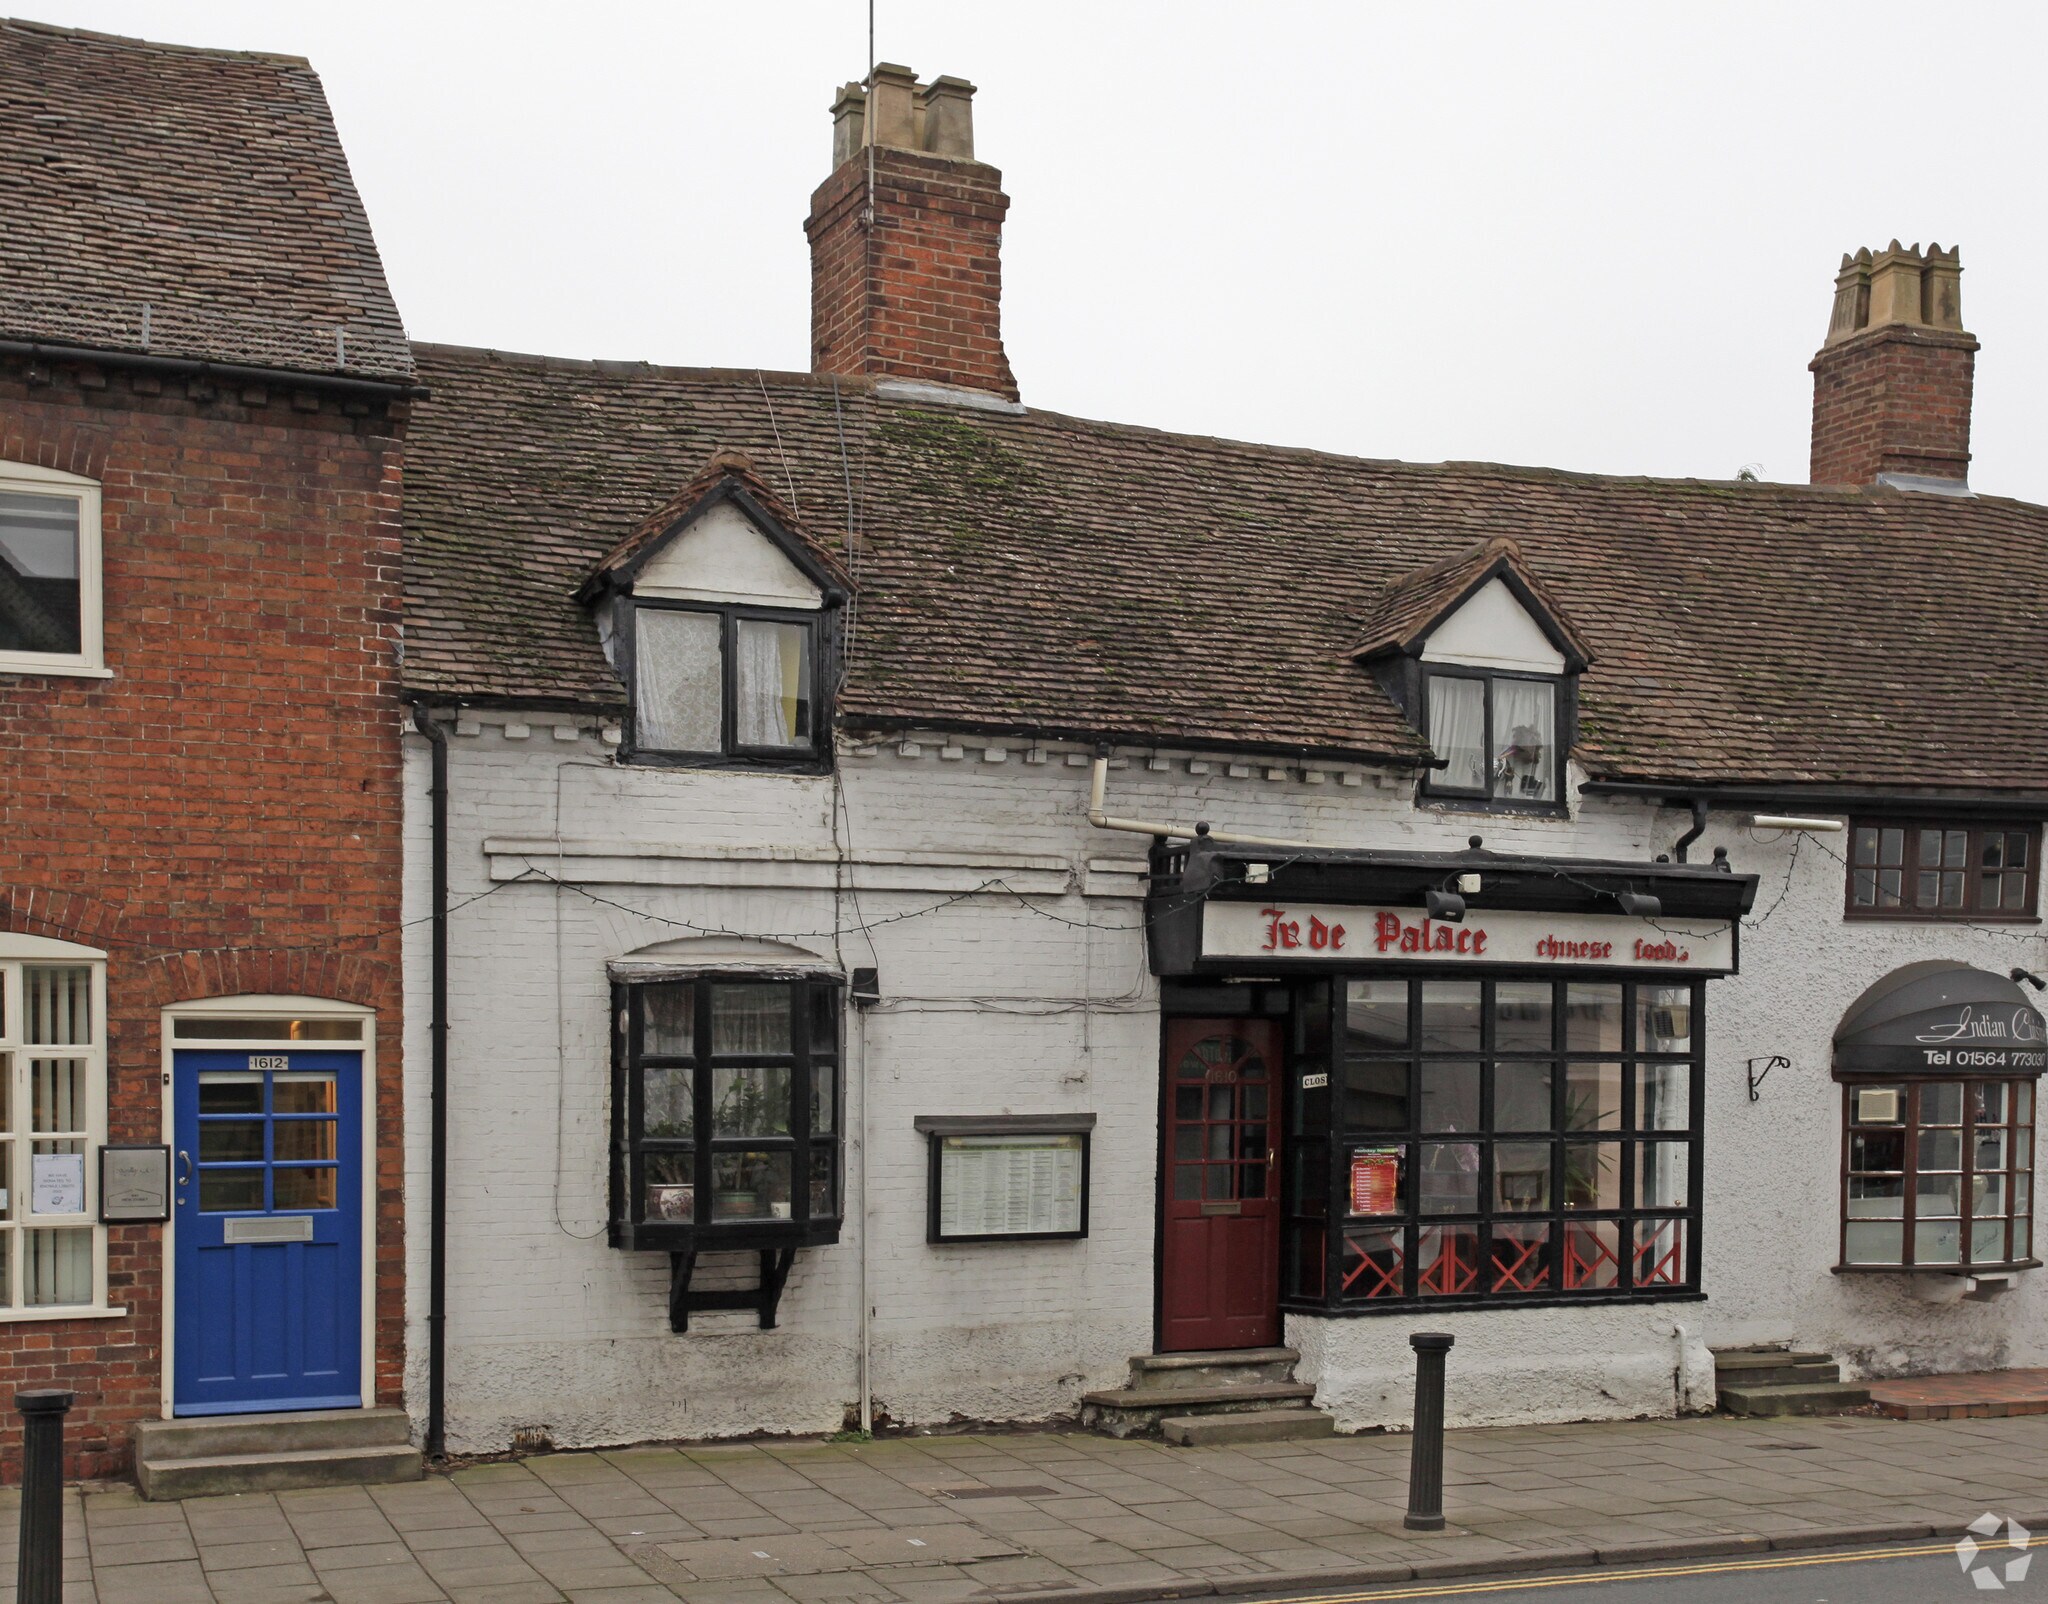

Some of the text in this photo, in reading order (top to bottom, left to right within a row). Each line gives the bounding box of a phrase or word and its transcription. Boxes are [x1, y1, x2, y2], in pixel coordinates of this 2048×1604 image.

[1375, 911, 1489, 954] Palace
[1536, 934, 1613, 960] chinese
[1915, 1005, 2007, 1043] Indian
[254, 1057, 283, 1068] 1612
[1923, 1050, 2046, 1066] Tel 01564 773030
[1210, 1070, 1237, 1083] 1610
